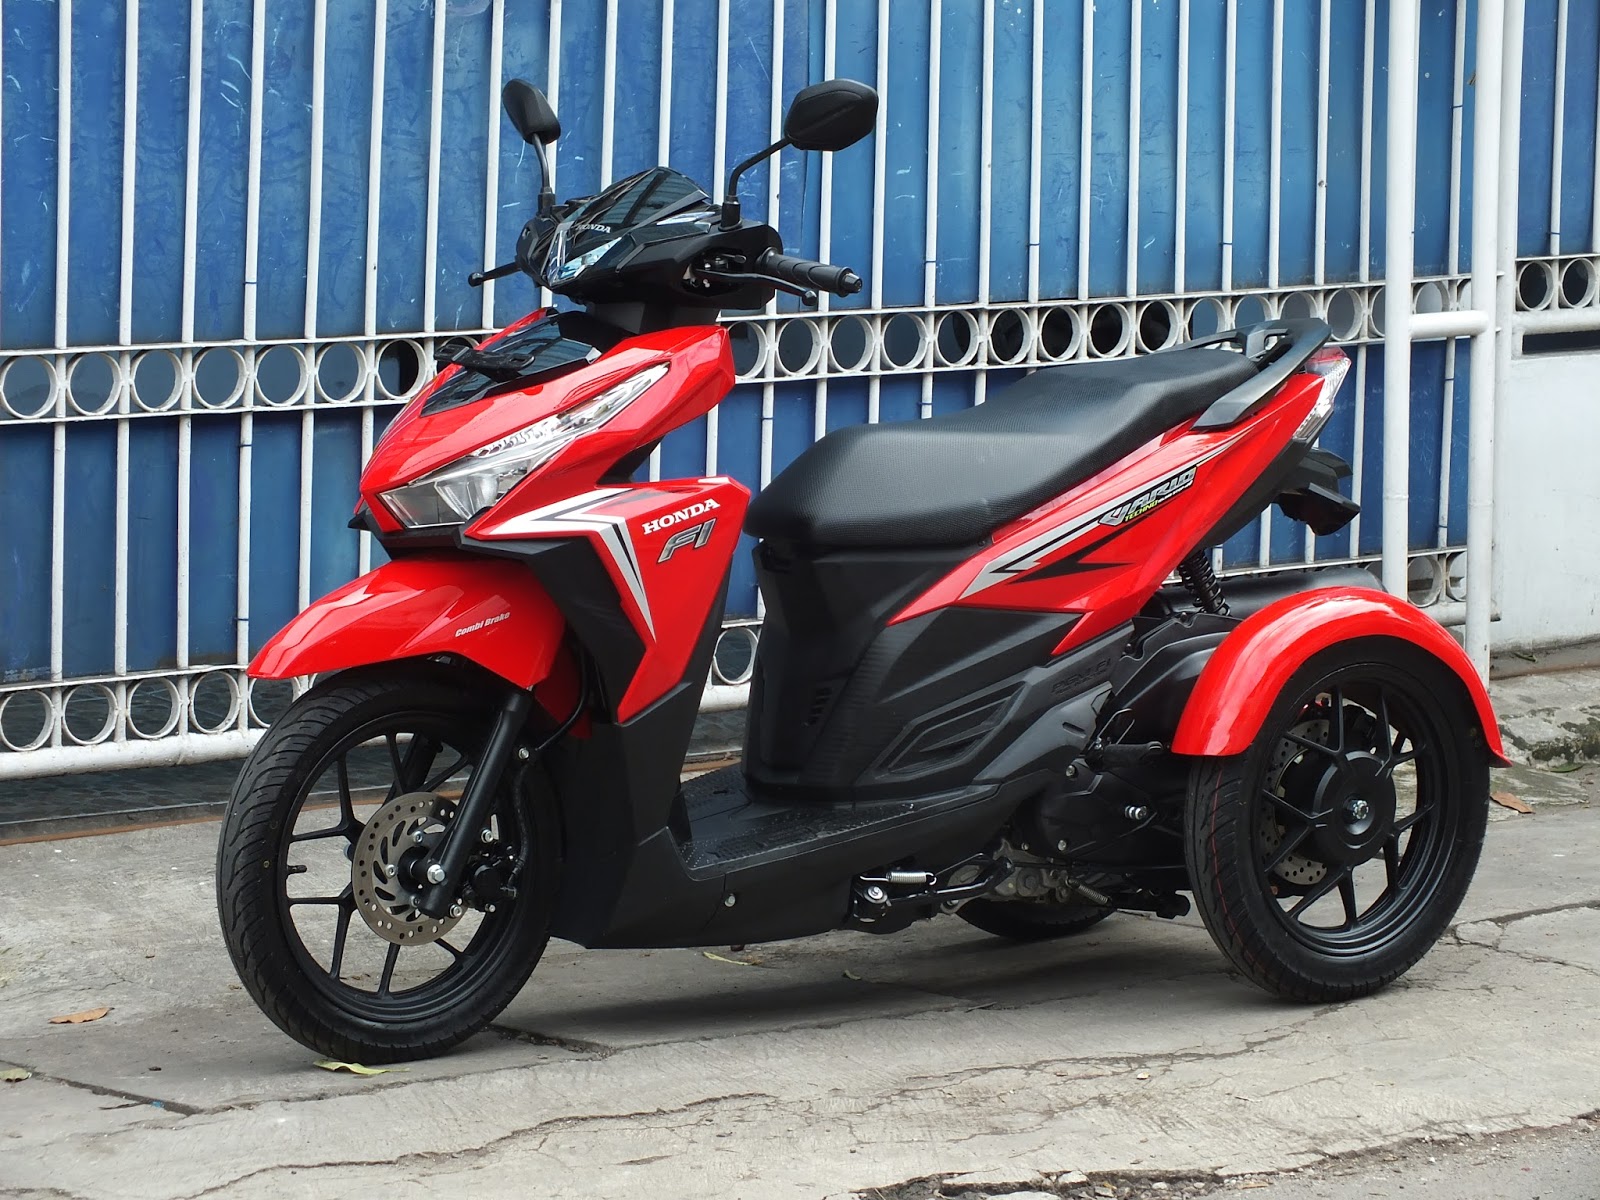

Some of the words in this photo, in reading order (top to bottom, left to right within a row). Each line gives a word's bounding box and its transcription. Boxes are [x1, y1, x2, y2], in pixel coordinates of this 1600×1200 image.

[575, 223, 611, 234] HONDA
[1098, 467, 1196, 526] VARIO
[1124, 500, 1159, 522] TECHNO
[642, 498, 721, 535] HONDA
[657, 517, 717, 564] FI
[455, 620, 484, 637] Combi
[484, 612, 511, 627] Brake
